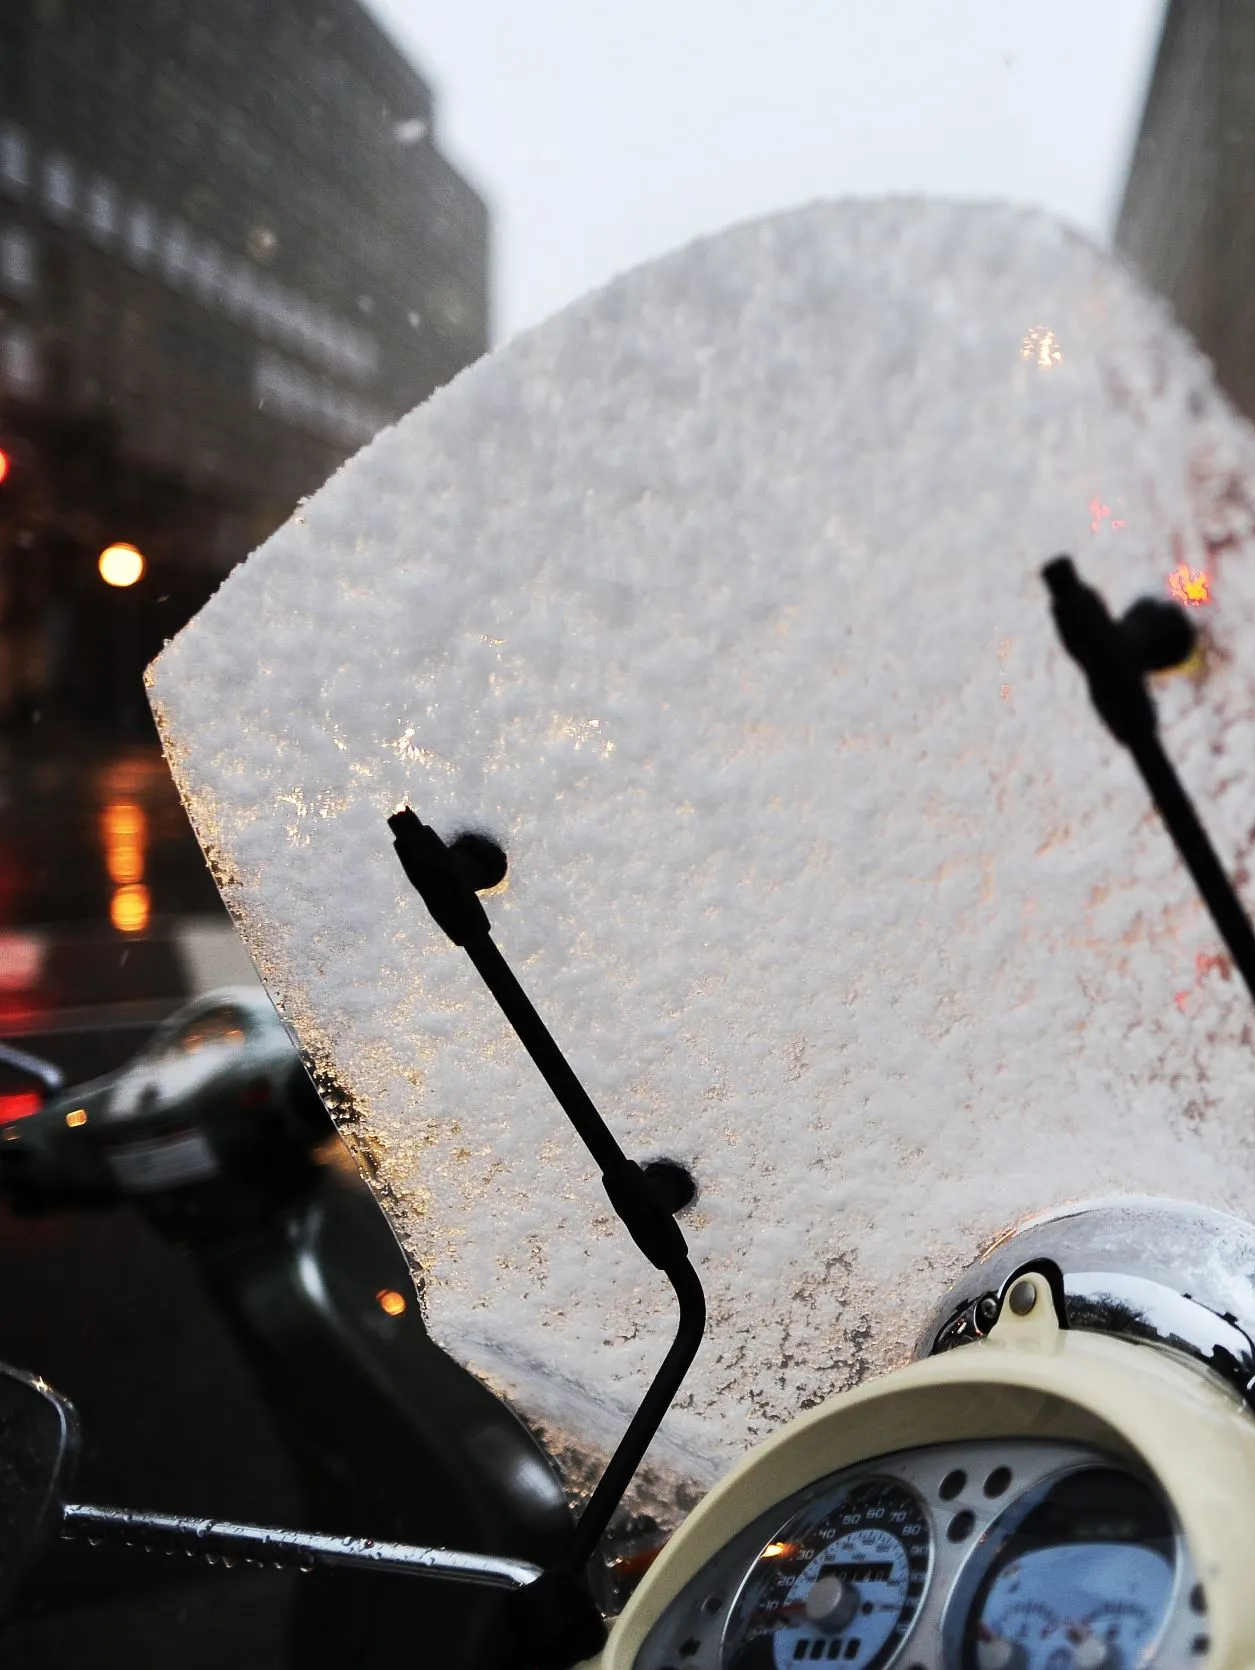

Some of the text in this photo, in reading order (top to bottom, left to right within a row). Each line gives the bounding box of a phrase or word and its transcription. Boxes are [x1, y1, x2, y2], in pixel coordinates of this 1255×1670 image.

[866, 1508, 885, 1519] 60
[889, 1511, 906, 1523] 70
[842, 1514, 861, 1525] 50
[819, 1529, 836, 1539] 40
[901, 1525, 921, 1536] 80
[799, 1549, 815, 1560] 30
[777, 1576, 795, 1587] 20
